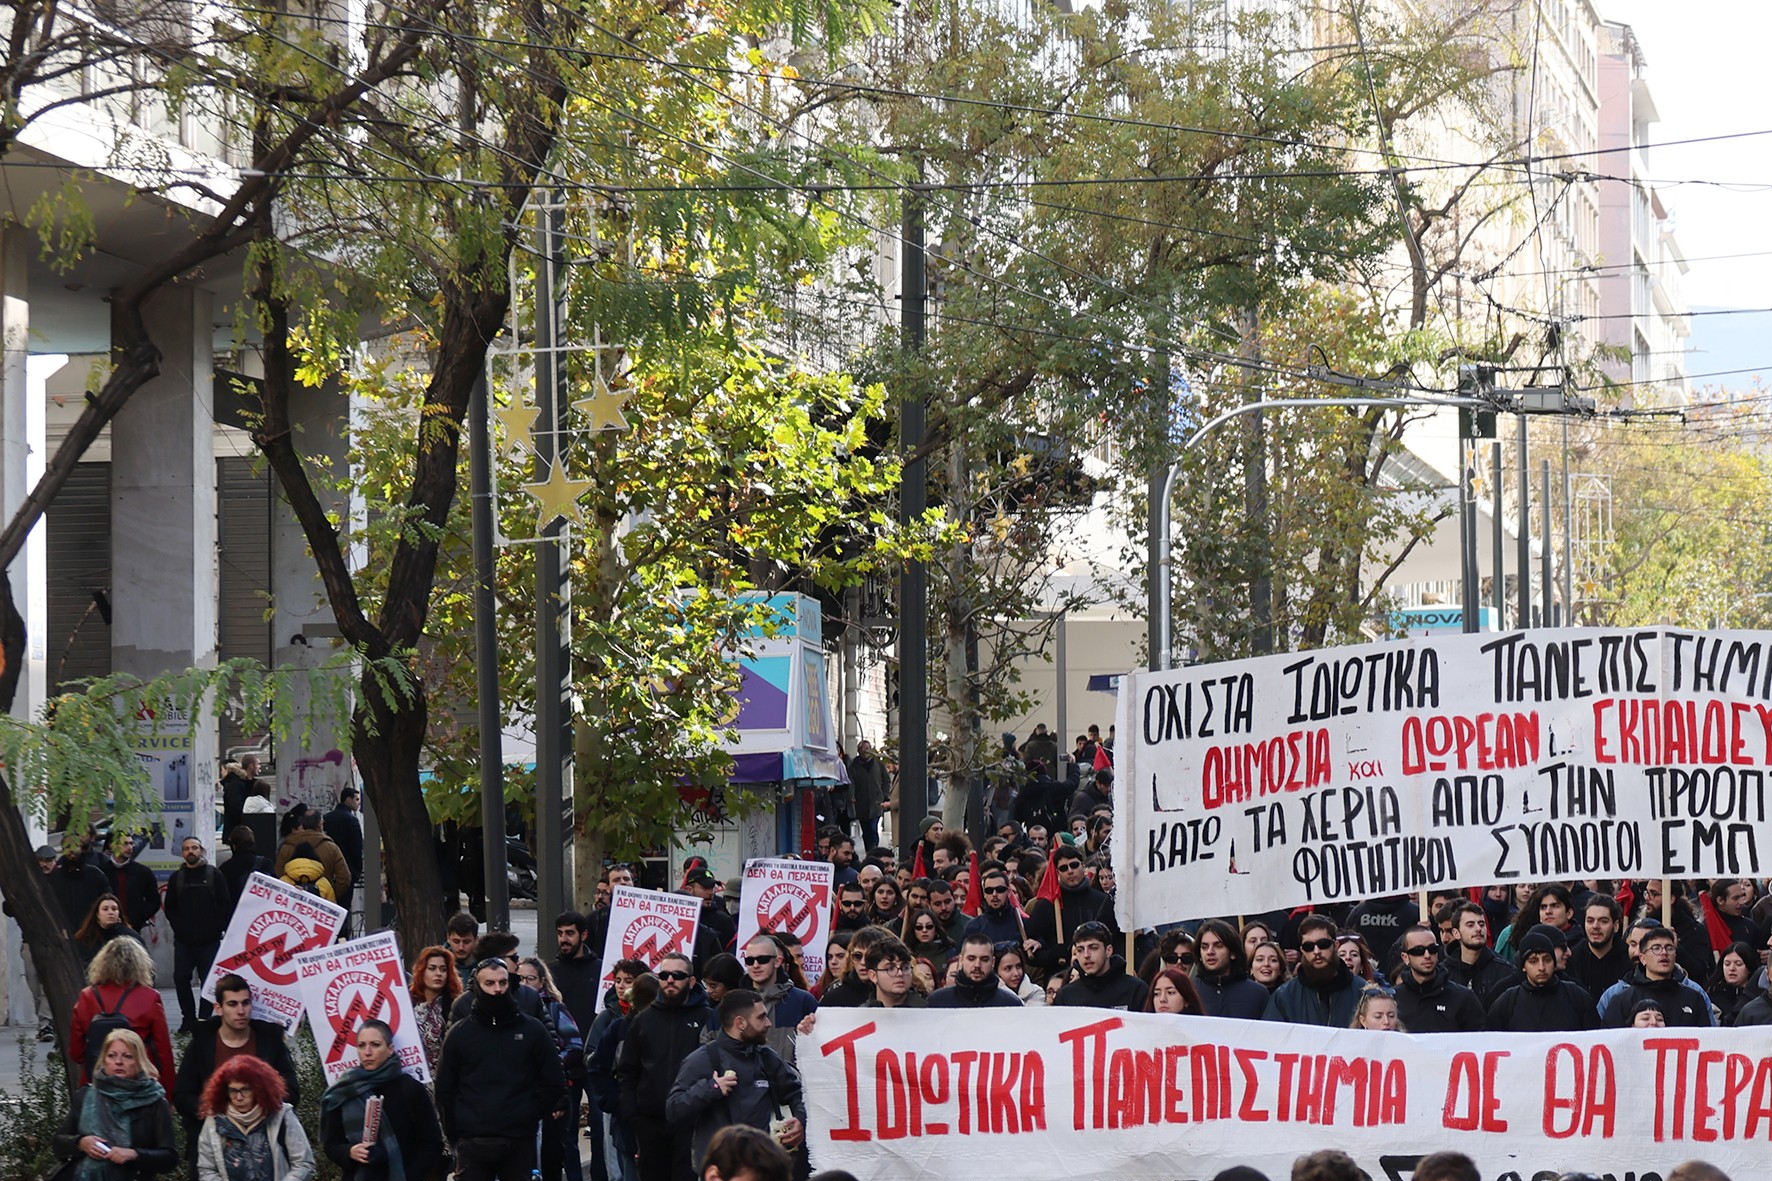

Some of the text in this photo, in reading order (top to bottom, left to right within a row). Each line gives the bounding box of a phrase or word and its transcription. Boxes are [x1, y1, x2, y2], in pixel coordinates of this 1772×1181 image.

[1143, 682, 1192, 745] ΟΧΙ
[1199, 672, 1254, 738] ΣΤΑ
[1283, 648, 1440, 724] ΙΔΙΩΤΙΚΑ
[1202, 728, 1332, 810] ΔΗΜΟΣΙΑ
[1402, 710, 1539, 776] ΔΩΡΕΑΝ
[1148, 816, 1221, 873] ΚΑΤΩ
[1244, 801, 1286, 853] ΤΑ
[1299, 786, 1402, 844] ΧΕΡΙΑ
[1433, 775, 1504, 827] ΑΠΟ
[1538, 762, 1615, 820] ΤΗΝ
[747, 868, 829, 883] ΔΕΝ ΘΑ ΠΕΡΑΣΕΙ
[1293, 819, 1759, 901] ΦΟΙΤΗΤΙΚΟΙ ΣΥΛΛΟΓΟΙ ΕΜΠ
[249, 884, 338, 928] ΔΕΝ ΘΑ ΠΕΡΑΣΕΙ
[616, 897, 697, 918] ΔΕΝ ΘΑ ΠΕΡΑΣΕΙ
[757, 884, 811, 915] ΚΑΤΑΛΗΨΕΙΣ
[248, 911, 311, 942] ΚΑΤΑΛΗΨΕΙΣ
[623, 916, 676, 946] ΚΑΤΑΛΗΨΕΙΣ
[301, 946, 394, 978] ΔΕΝ ΘΑ ΠΕΡΑΣΕΙ
[325, 971, 381, 1017] ΚΑΤΑΛΗΨΕΙΣ
[821, 1021, 1046, 1142] ΙΔΙΩΤΙΚΑ
[1059, 1016, 1406, 1131] ΠΑΝΕΠΙΣΤΗΜΙΑ
[1442, 1050, 1511, 1132] ΔΕ
[1541, 1042, 1617, 1139] ΘΑ
